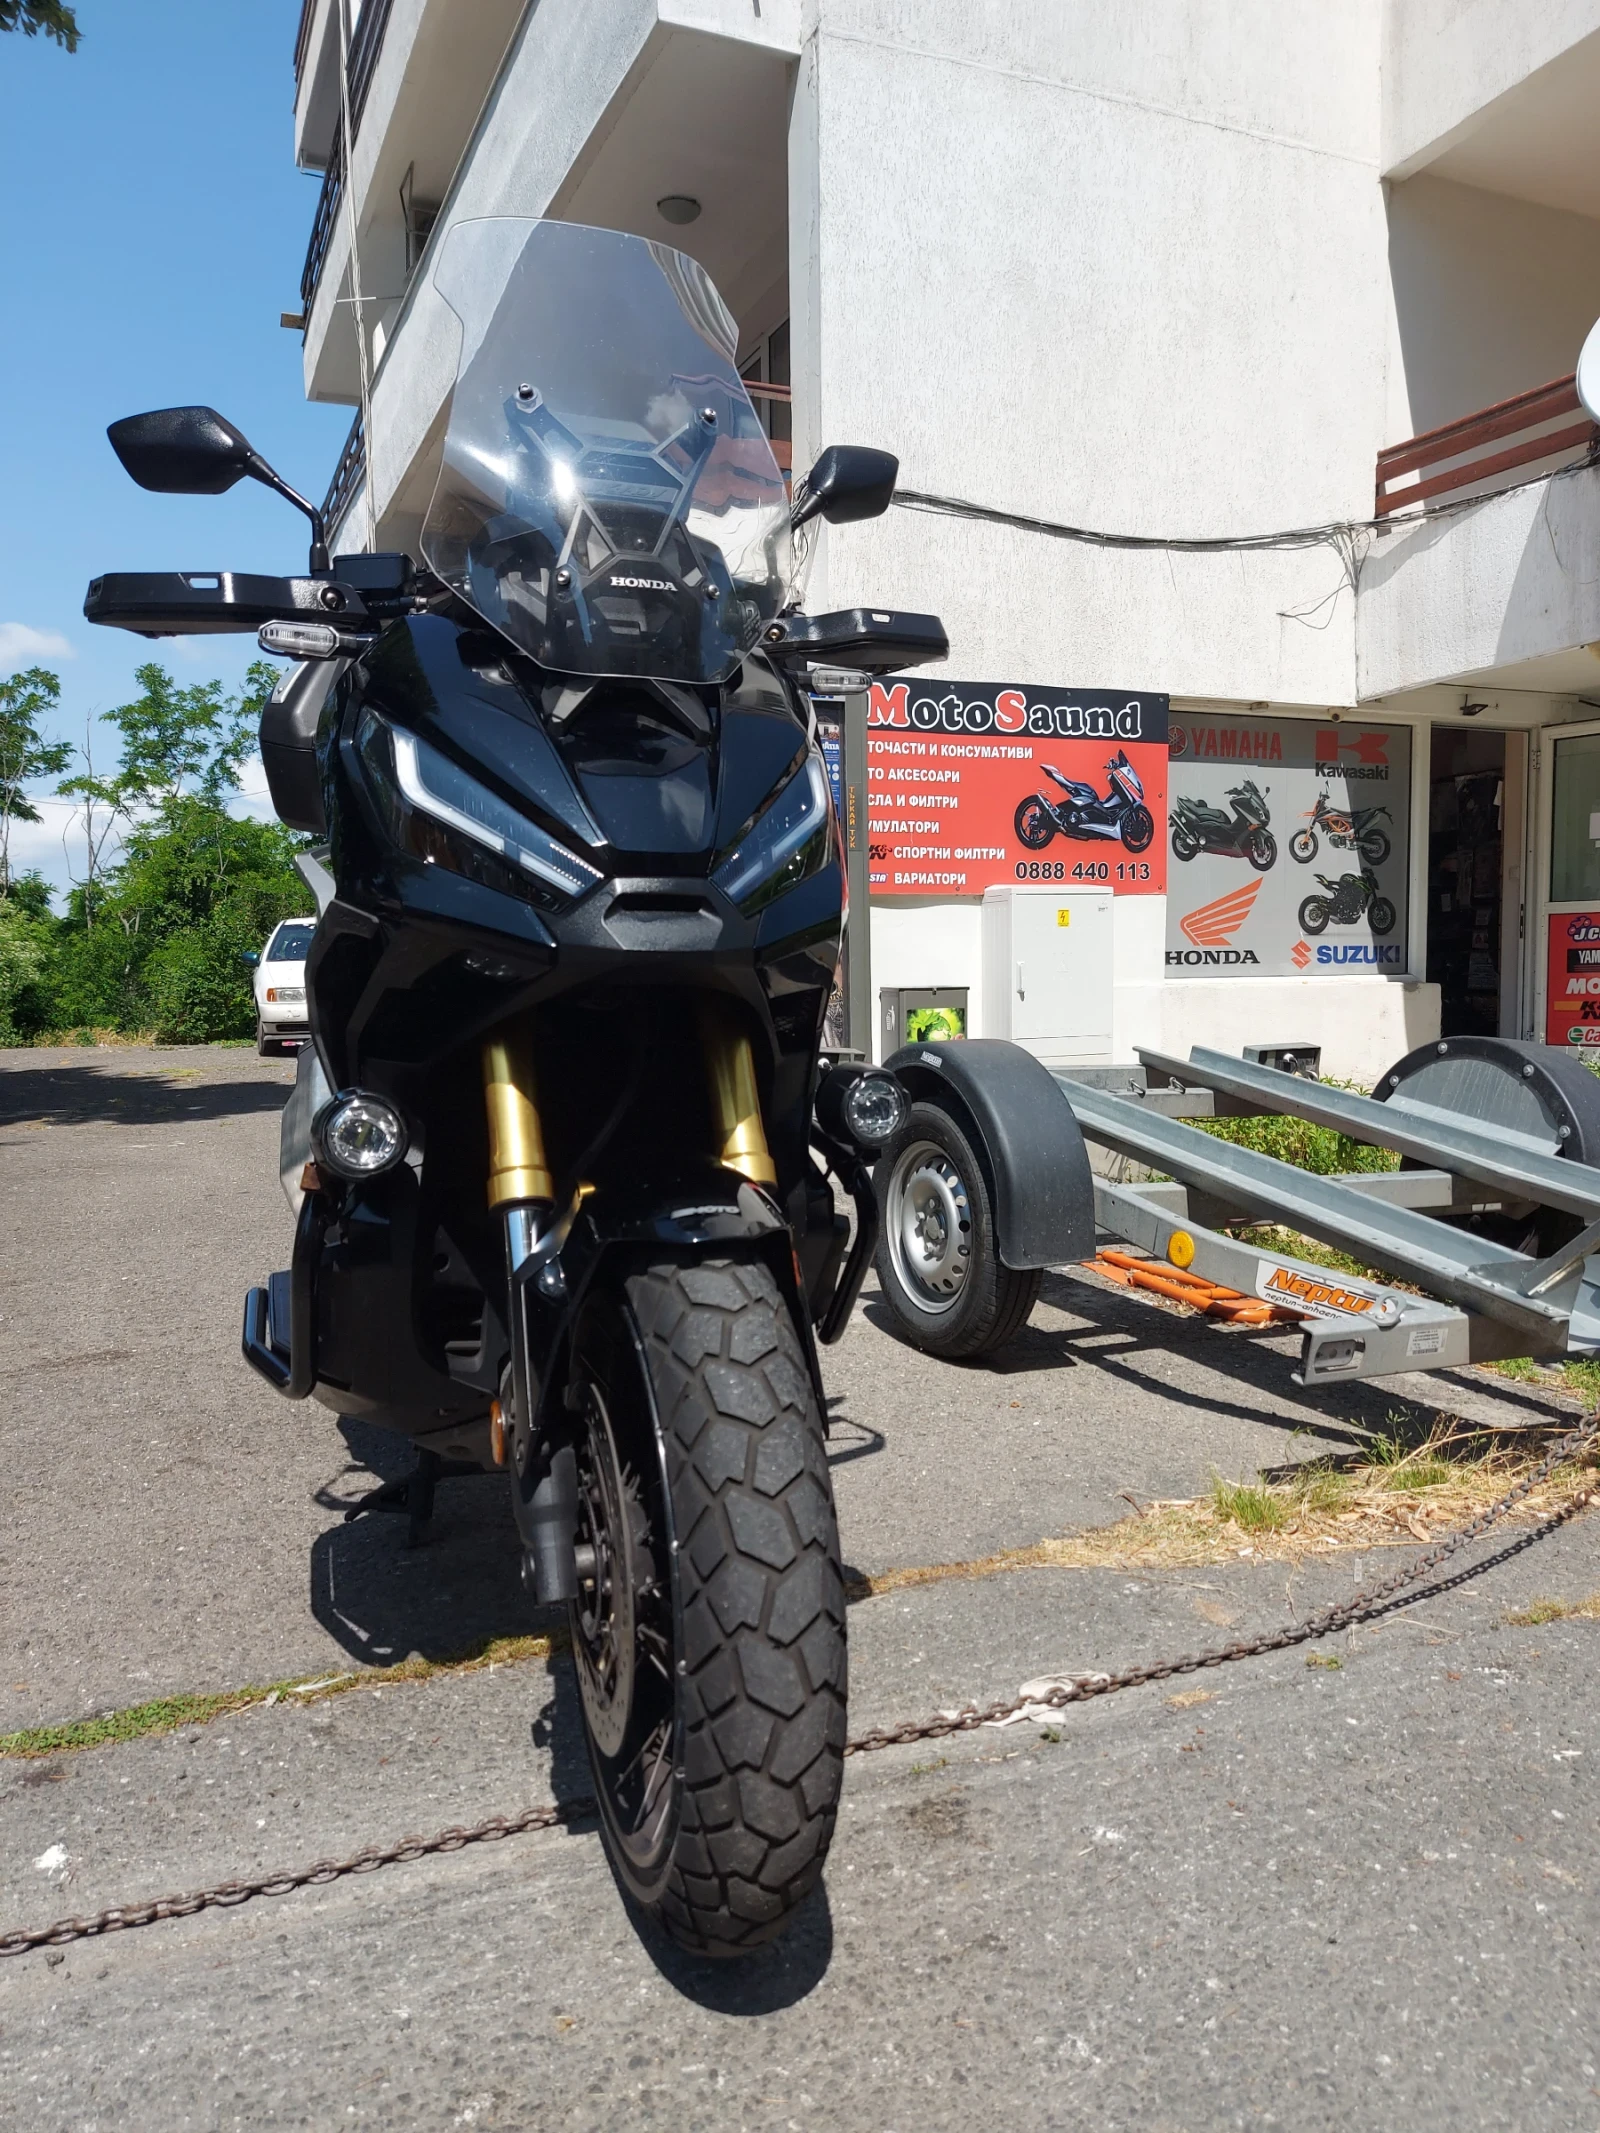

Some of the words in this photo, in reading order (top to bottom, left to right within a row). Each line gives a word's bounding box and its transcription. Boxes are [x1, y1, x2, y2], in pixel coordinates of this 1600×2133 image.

[609, 576, 678, 592] HONDA
[868, 682, 1142, 738] MotoSaund
[868, 740, 926, 756] ТОЧАСТИ
[929, 743, 938, 757] И
[941, 745, 1033, 759] КОНСУМАТИВИ
[1191, 727, 1283, 761] YAMAHA
[868, 767, 884, 780] ТО
[888, 768, 960, 783] АКСЕСОАРИ
[1315, 762, 1389, 781] Kawasaki
[868, 793, 893, 806] СЛА
[896, 794, 906, 807] И
[909, 795, 958, 808] ФИЛТРИ
[894, 846, 951, 859] СПОРТНИ
[954, 848, 1006, 860] ФИЛТРИ
[894, 873, 966, 884] ВАРИАТОРИ
[1015, 861, 1064, 880] 0888
[1071, 862, 1109, 880] 440
[1116, 862, 1150, 880] 113
[1165, 950, 1260, 966] HONDA
[1317, 945, 1400, 964] SUZUKI
